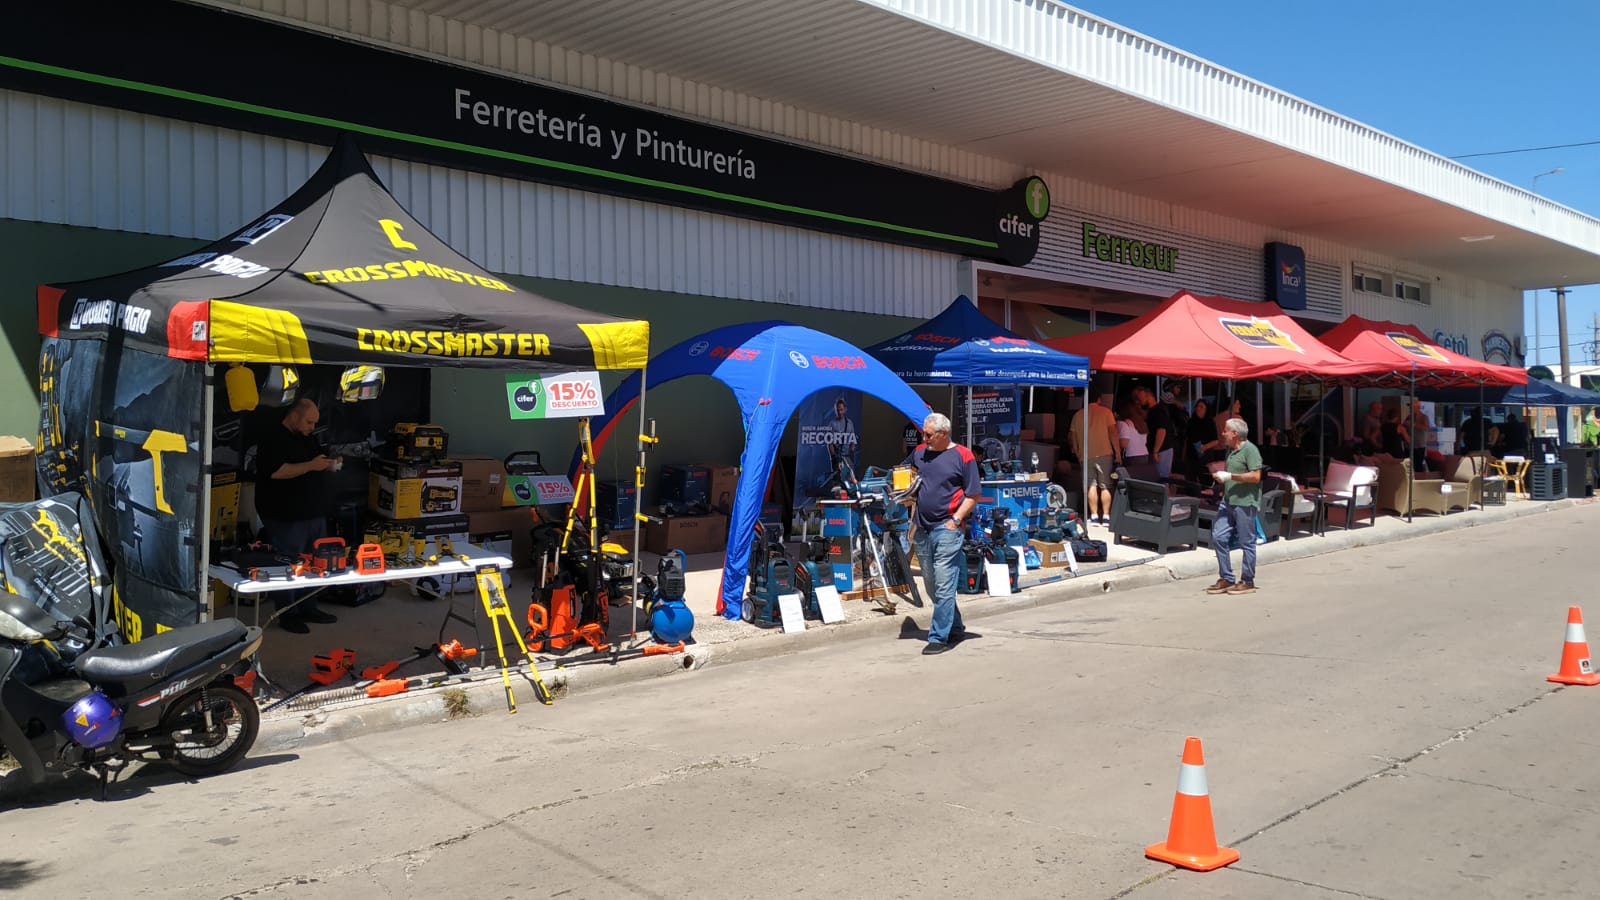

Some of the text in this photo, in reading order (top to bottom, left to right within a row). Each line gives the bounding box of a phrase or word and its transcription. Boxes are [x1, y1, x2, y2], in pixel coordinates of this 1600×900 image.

[455, 88, 756, 180] Ferretería y Pinturería
[999, 213, 1034, 238] cifer
[1082, 222, 1179, 273] Ferrosur
[303, 259, 516, 293] CROSSMASTER
[1282, 271, 1299, 287] Inca
[357, 327, 551, 357] CROSSMASTER
[811, 355, 867, 369] BOSCH
[516, 394, 534, 402] cifer
[549, 382, 596, 401] 15%
[551, 400, 598, 408] DESCUENTO
[801, 432, 857, 445] RECORTA
[537, 482, 570, 493] 15%
[1002, 486, 1042, 498] DREMEL
